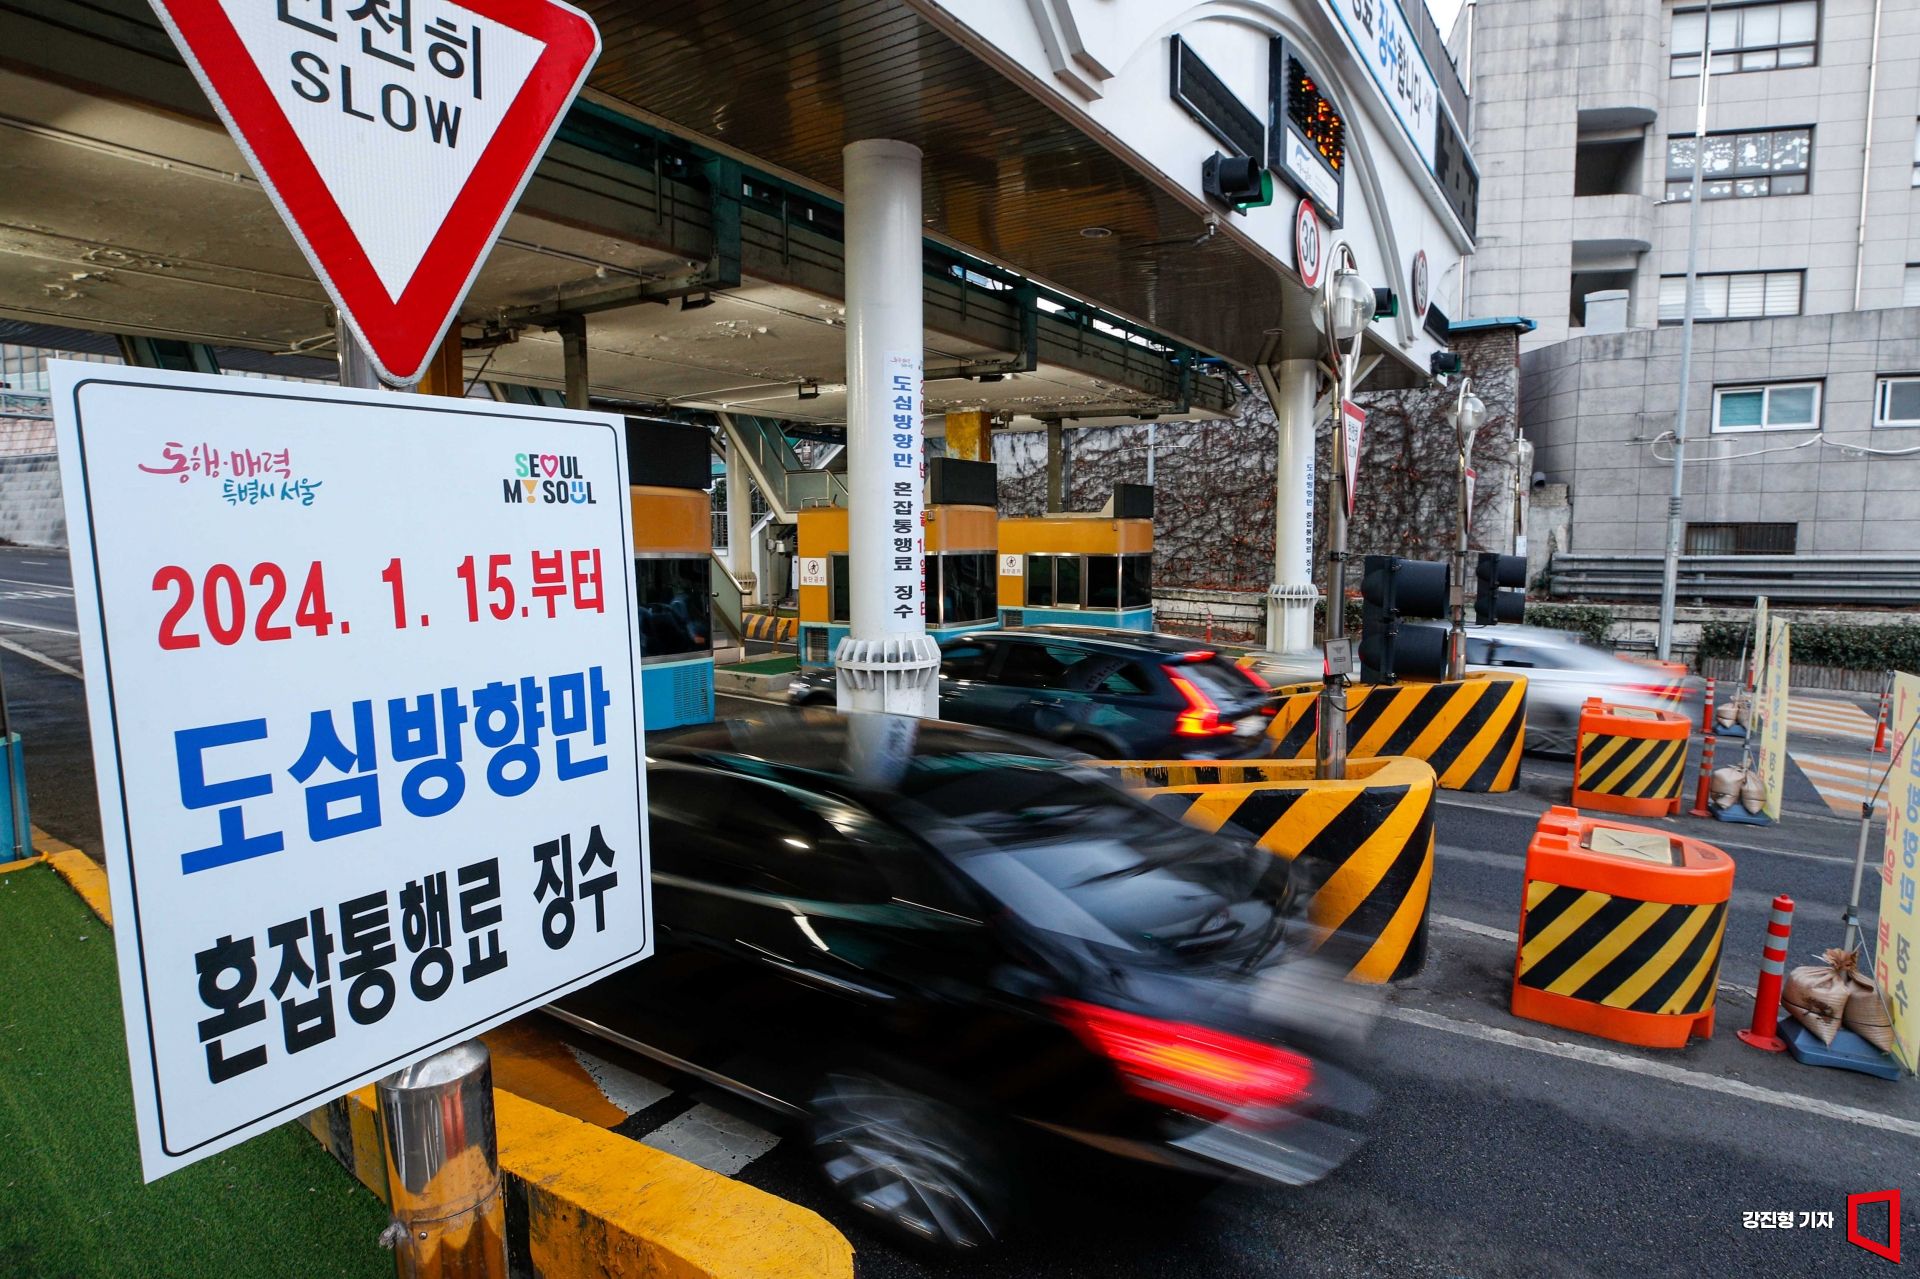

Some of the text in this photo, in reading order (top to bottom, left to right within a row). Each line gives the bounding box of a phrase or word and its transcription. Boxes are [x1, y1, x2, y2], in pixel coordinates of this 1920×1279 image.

[290, 50, 463, 149] SLOW
[1302, 219, 1316, 267] 30
[892, 375, 913, 468] 도심방향만
[222, 478, 323, 506] 특별시 서울
[542, 479, 597, 504] SOUL
[892, 481, 913, 571] 혼잡통행료
[151, 560, 350, 650] 2024.
[381, 557, 429, 629] 1.
[893, 585, 914, 619] 징수
[174, 665, 611, 875] 도심방향만
[194, 824, 618, 1084] 혼잡통행료 징수
